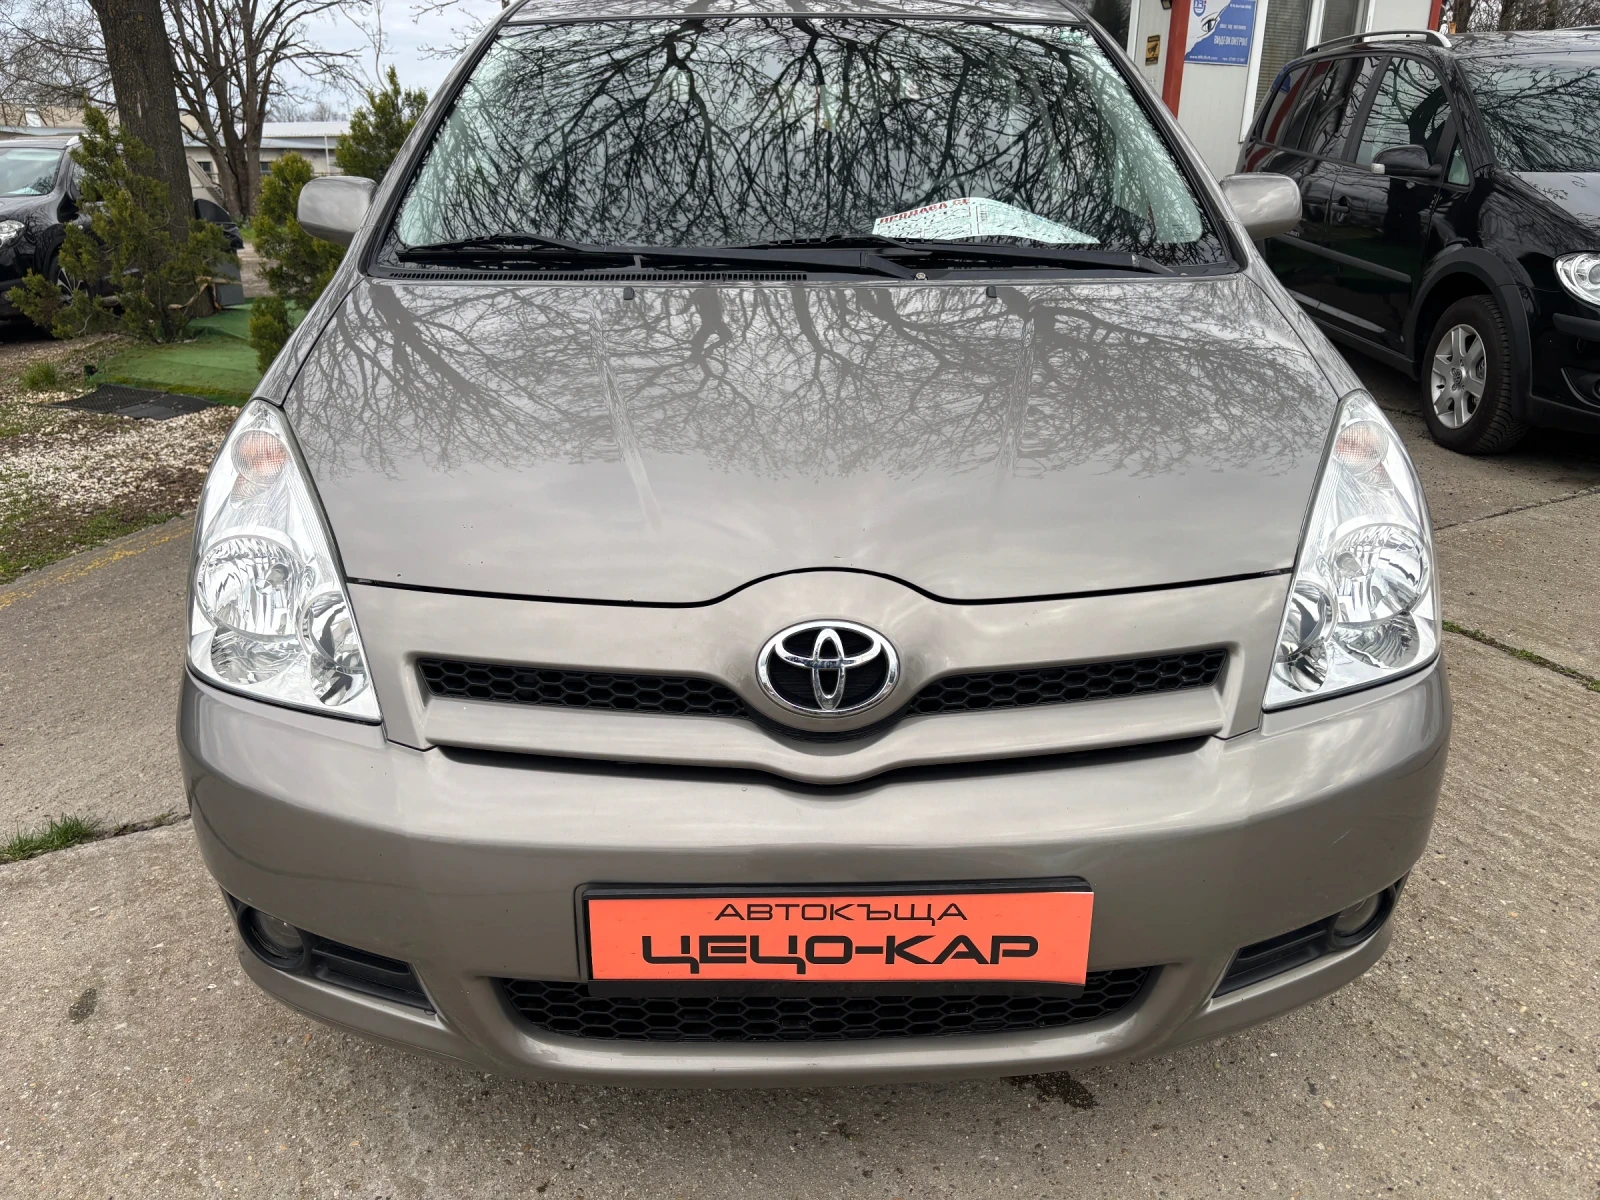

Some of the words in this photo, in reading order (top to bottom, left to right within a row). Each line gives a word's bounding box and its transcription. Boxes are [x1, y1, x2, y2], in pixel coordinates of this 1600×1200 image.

[879, 202, 948, 224] ПРОДАВА
[714, 903, 968, 927] АВТОКЪЩА
[642, 935, 1039, 975] ЦЕЦО-КАР
